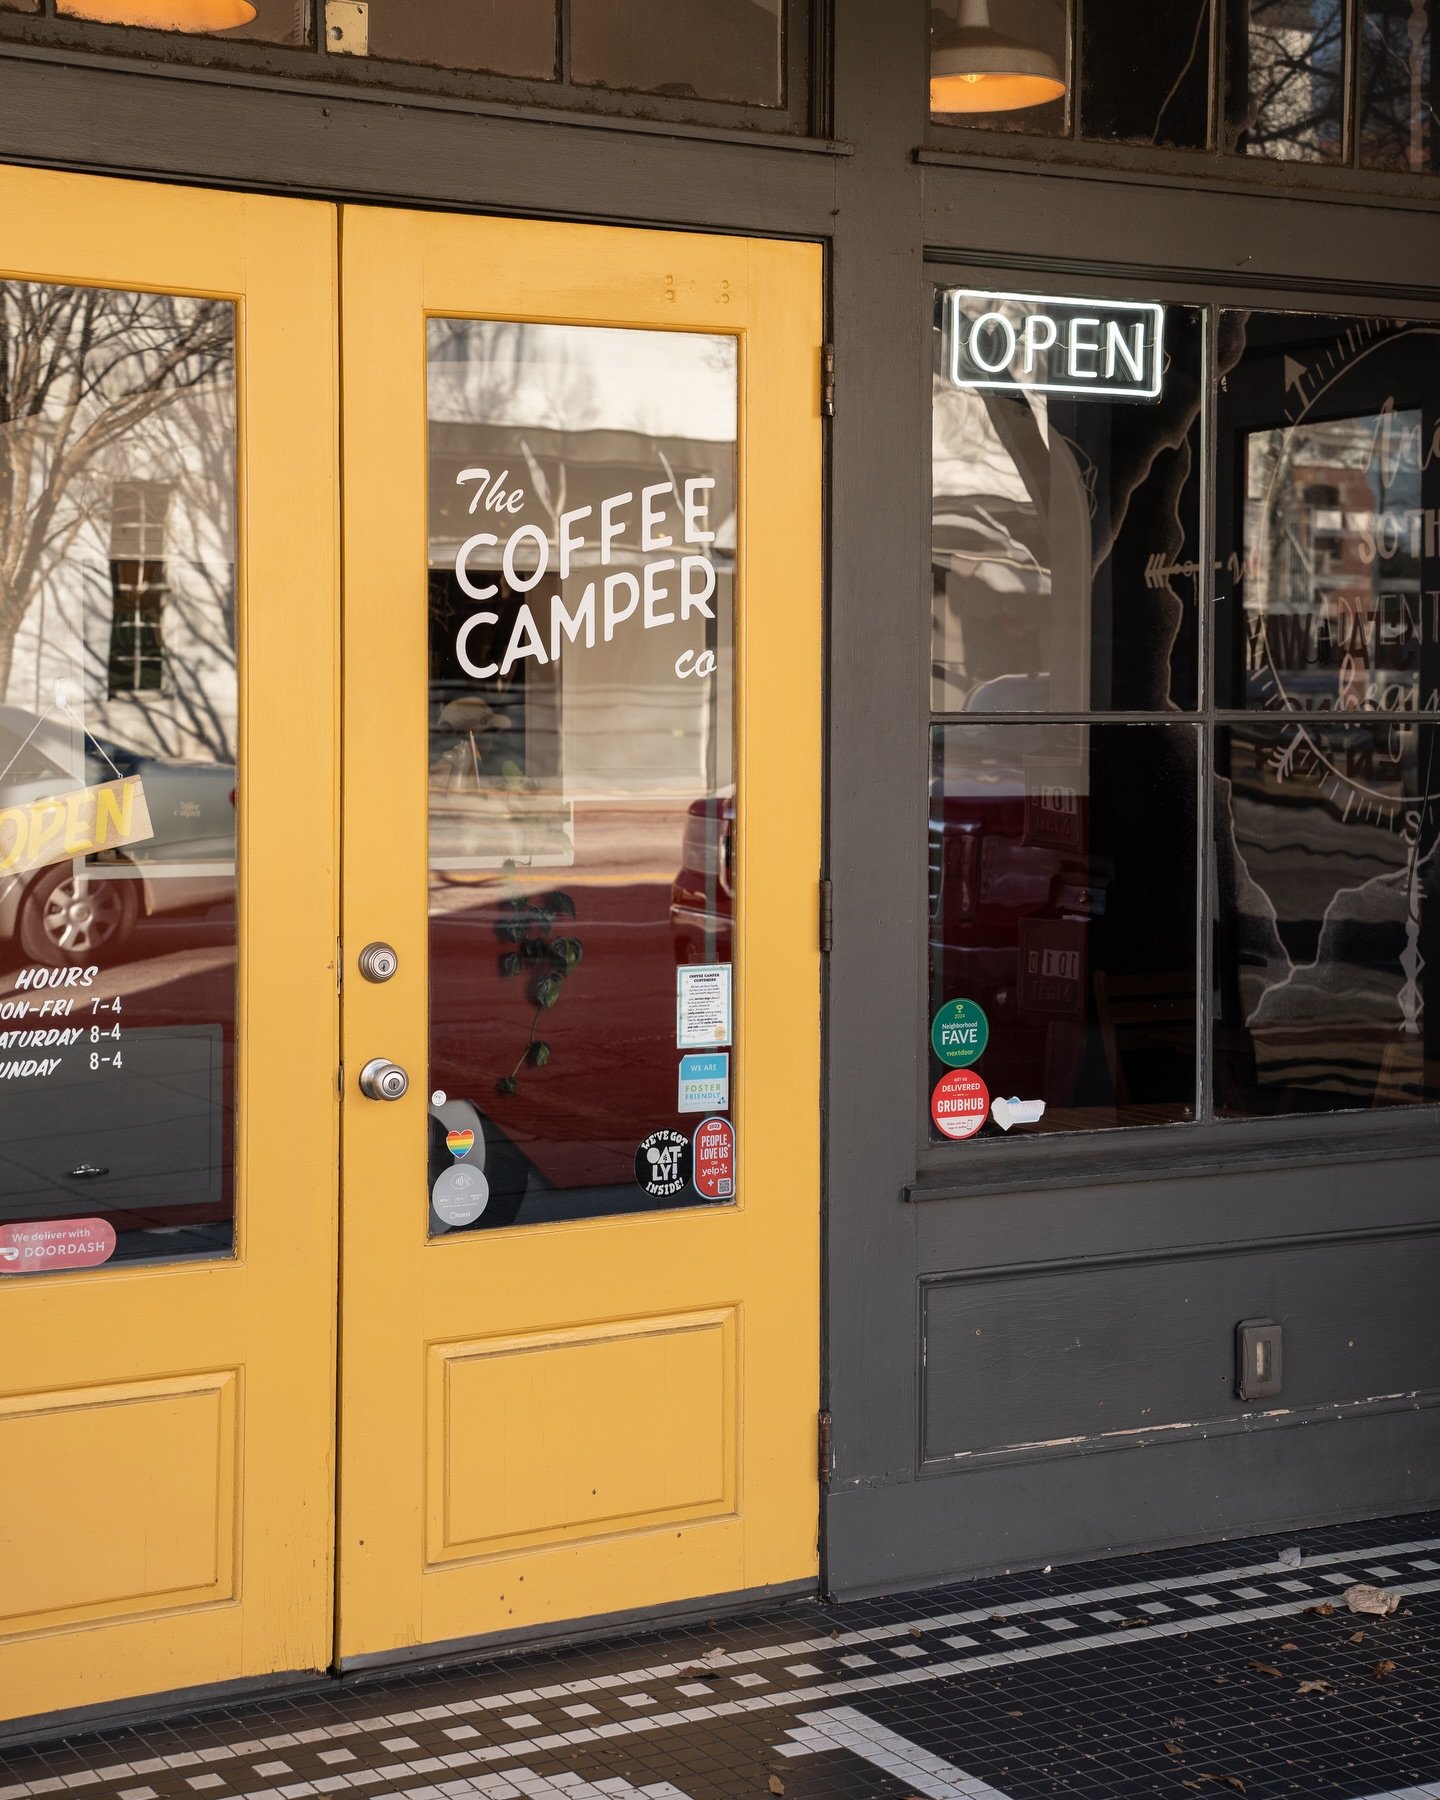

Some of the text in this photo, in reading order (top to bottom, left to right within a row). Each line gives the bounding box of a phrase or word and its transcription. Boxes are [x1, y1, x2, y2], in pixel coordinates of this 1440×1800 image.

[969, 312, 1144, 382] OPEN
[456, 468, 524, 514] The
[455, 477, 716, 600] COFFEE
[455, 555, 716, 679] CAMPER
[0, 782, 135, 870] OPEN
[15, 966, 98, 990] HOURS
[0, 996, 122, 1020] ON-FRI 7-4
[90, 1023, 121, 1043] 8-4
[942, 1029, 978, 1045] FAVE
[90, 1051, 123, 1070] 8-4
[690, 1063, 718, 1072] WE ARE
[685, 1083, 721, 1092] FOSTER
[685, 1092, 721, 1100] FRIENDLY
[942, 1083, 980, 1092] DELIVERED
[937, 1098, 984, 1113] GRUBHUB
[641, 1130, 689, 1150] WE'VE GOT
[701, 1134, 728, 1148] PEOPLE
[700, 1146, 729, 1160] LOVE US
[701, 1166, 720, 1177] yelp
[645, 1177, 684, 1196] INSIDE!
[12, 1228, 91, 1242] We deliver with
[24, 1241, 105, 1257] DOORDASH
